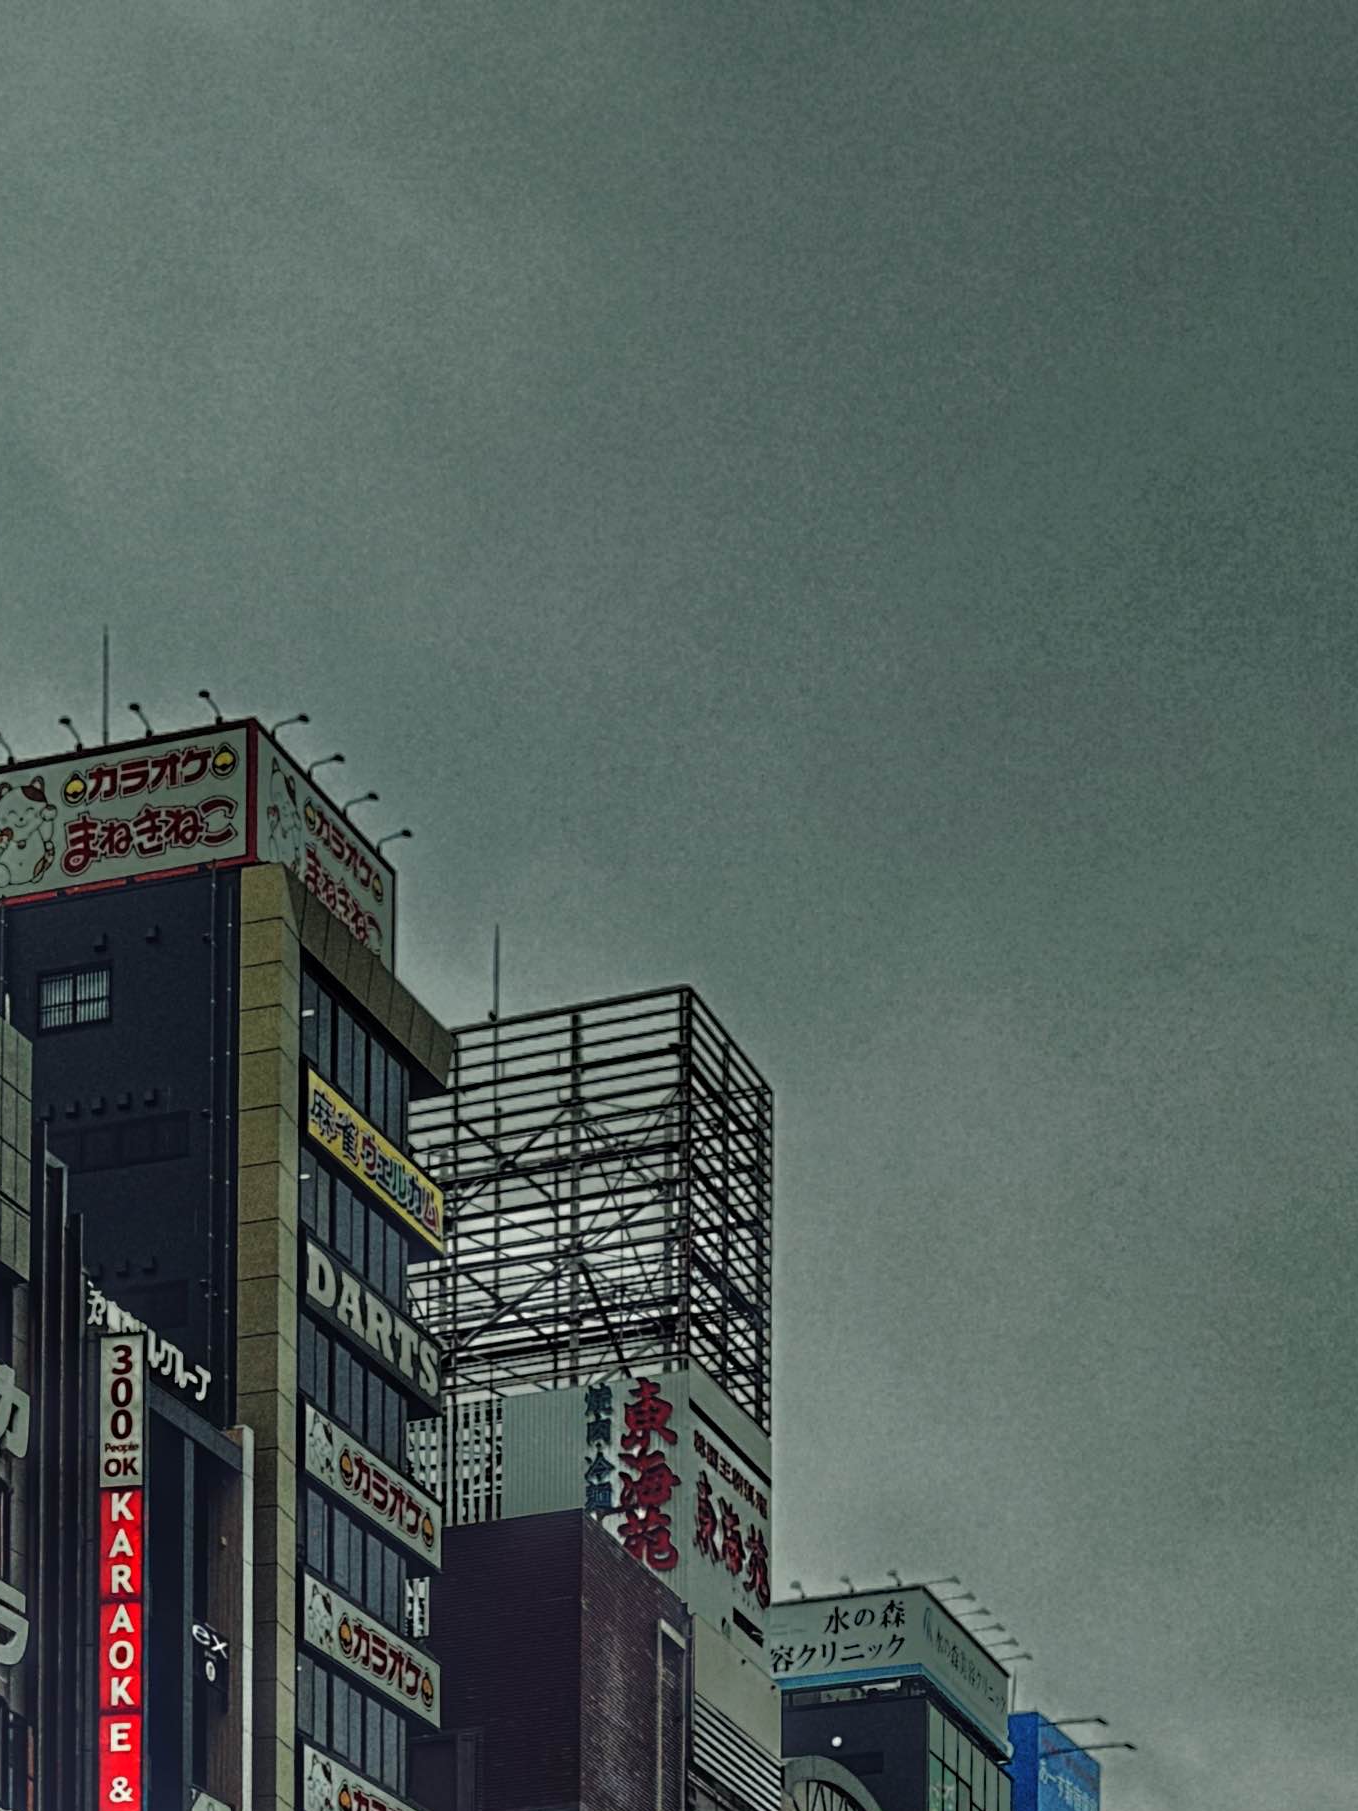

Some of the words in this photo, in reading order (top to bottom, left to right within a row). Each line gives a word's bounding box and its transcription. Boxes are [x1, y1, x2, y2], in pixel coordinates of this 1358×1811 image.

[85, 742, 213, 803] カラオケ
[60, 794, 238, 877] まねきねこ
[312, 800, 374, 883] カラオケ
[305, 1242, 441, 1400] DARTS
[108, 1344, 134, 1443] 300
[103, 1442, 139, 1454] People
[103, 1457, 139, 1477] OK
[349, 1454, 425, 1548] カラオケ
[106, 1489, 137, 1754] KARAOKE
[770, 1634, 906, 1674] 容クリニック
[823, 1599, 906, 1635] 水の森
[350, 1622, 423, 1698] カラオケ
[106, 1775, 135, 1805] &
